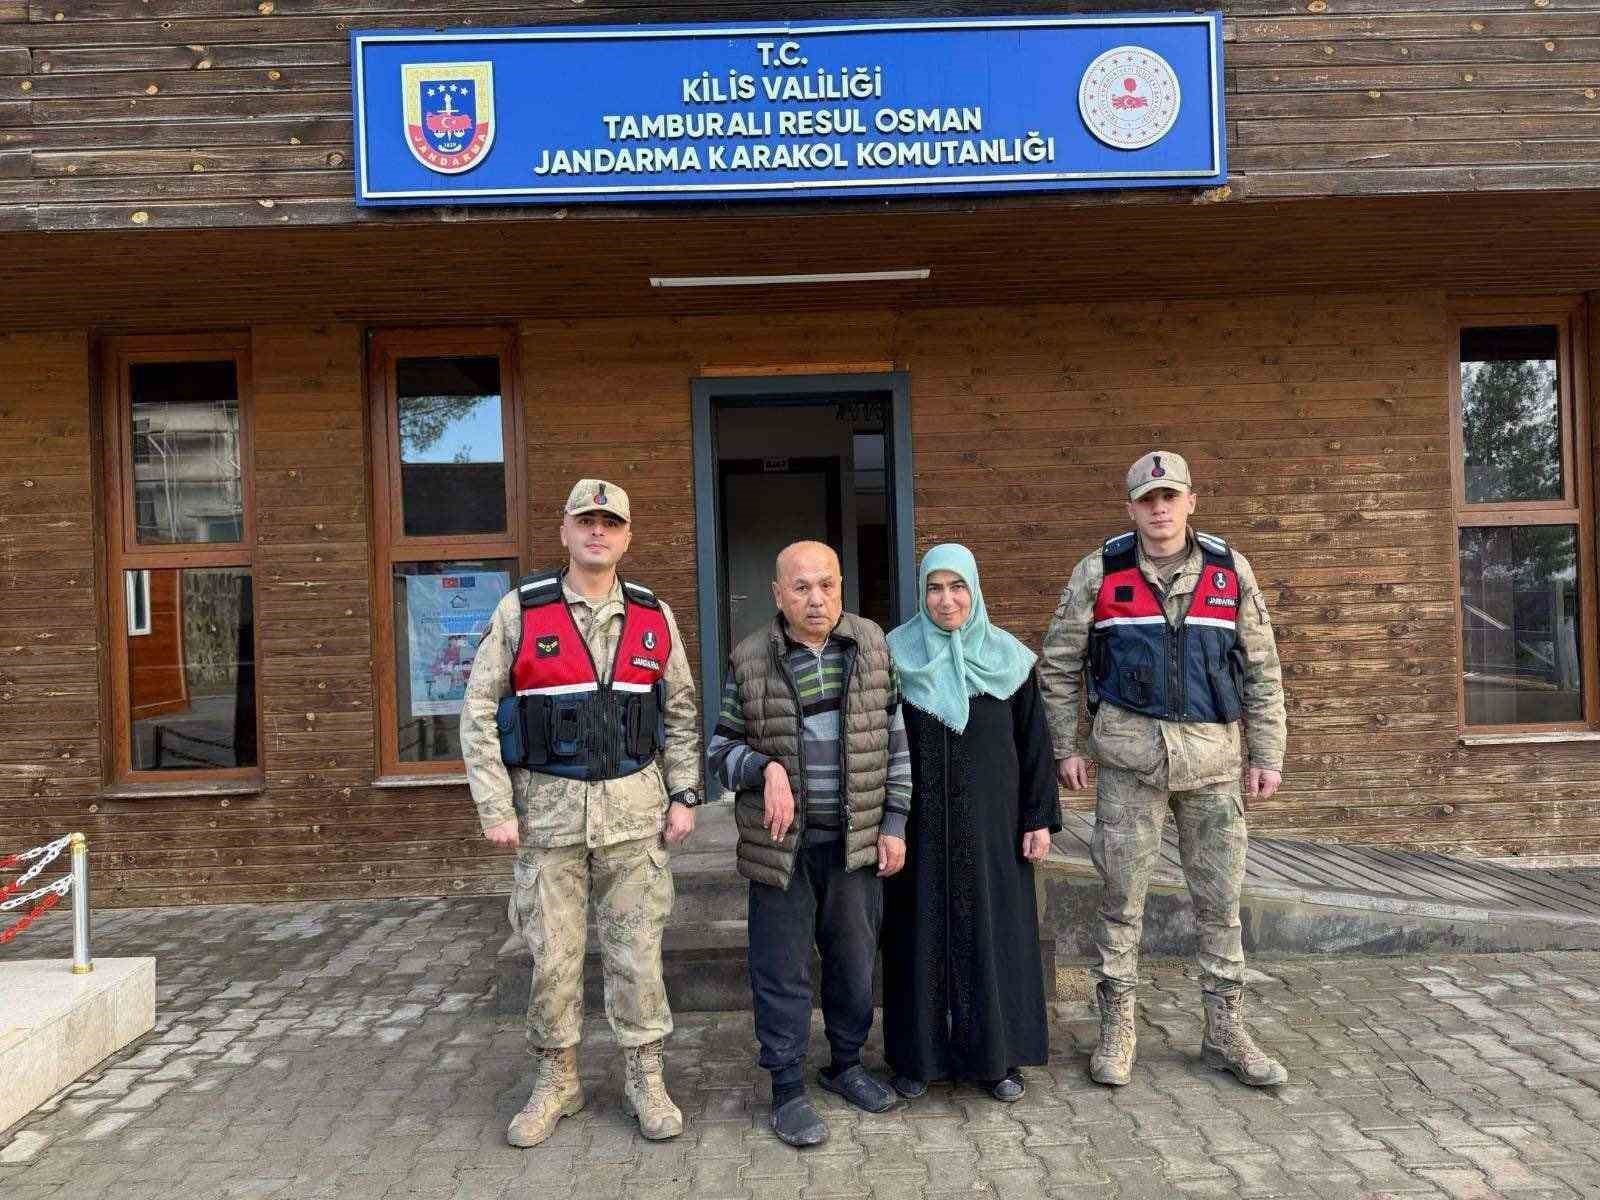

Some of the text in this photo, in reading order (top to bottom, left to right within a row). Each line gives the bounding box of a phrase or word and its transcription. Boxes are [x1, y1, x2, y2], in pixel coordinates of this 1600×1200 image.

[757, 41, 808, 67] T.C.
[682, 66, 882, 102] KİLİS VALİLİĞİ
[603, 106, 983, 139] TAMBURALI RESUL OSMAN
[534, 131, 1056, 174] JANDARMA KARAKOL KOMUTANLIĞI
